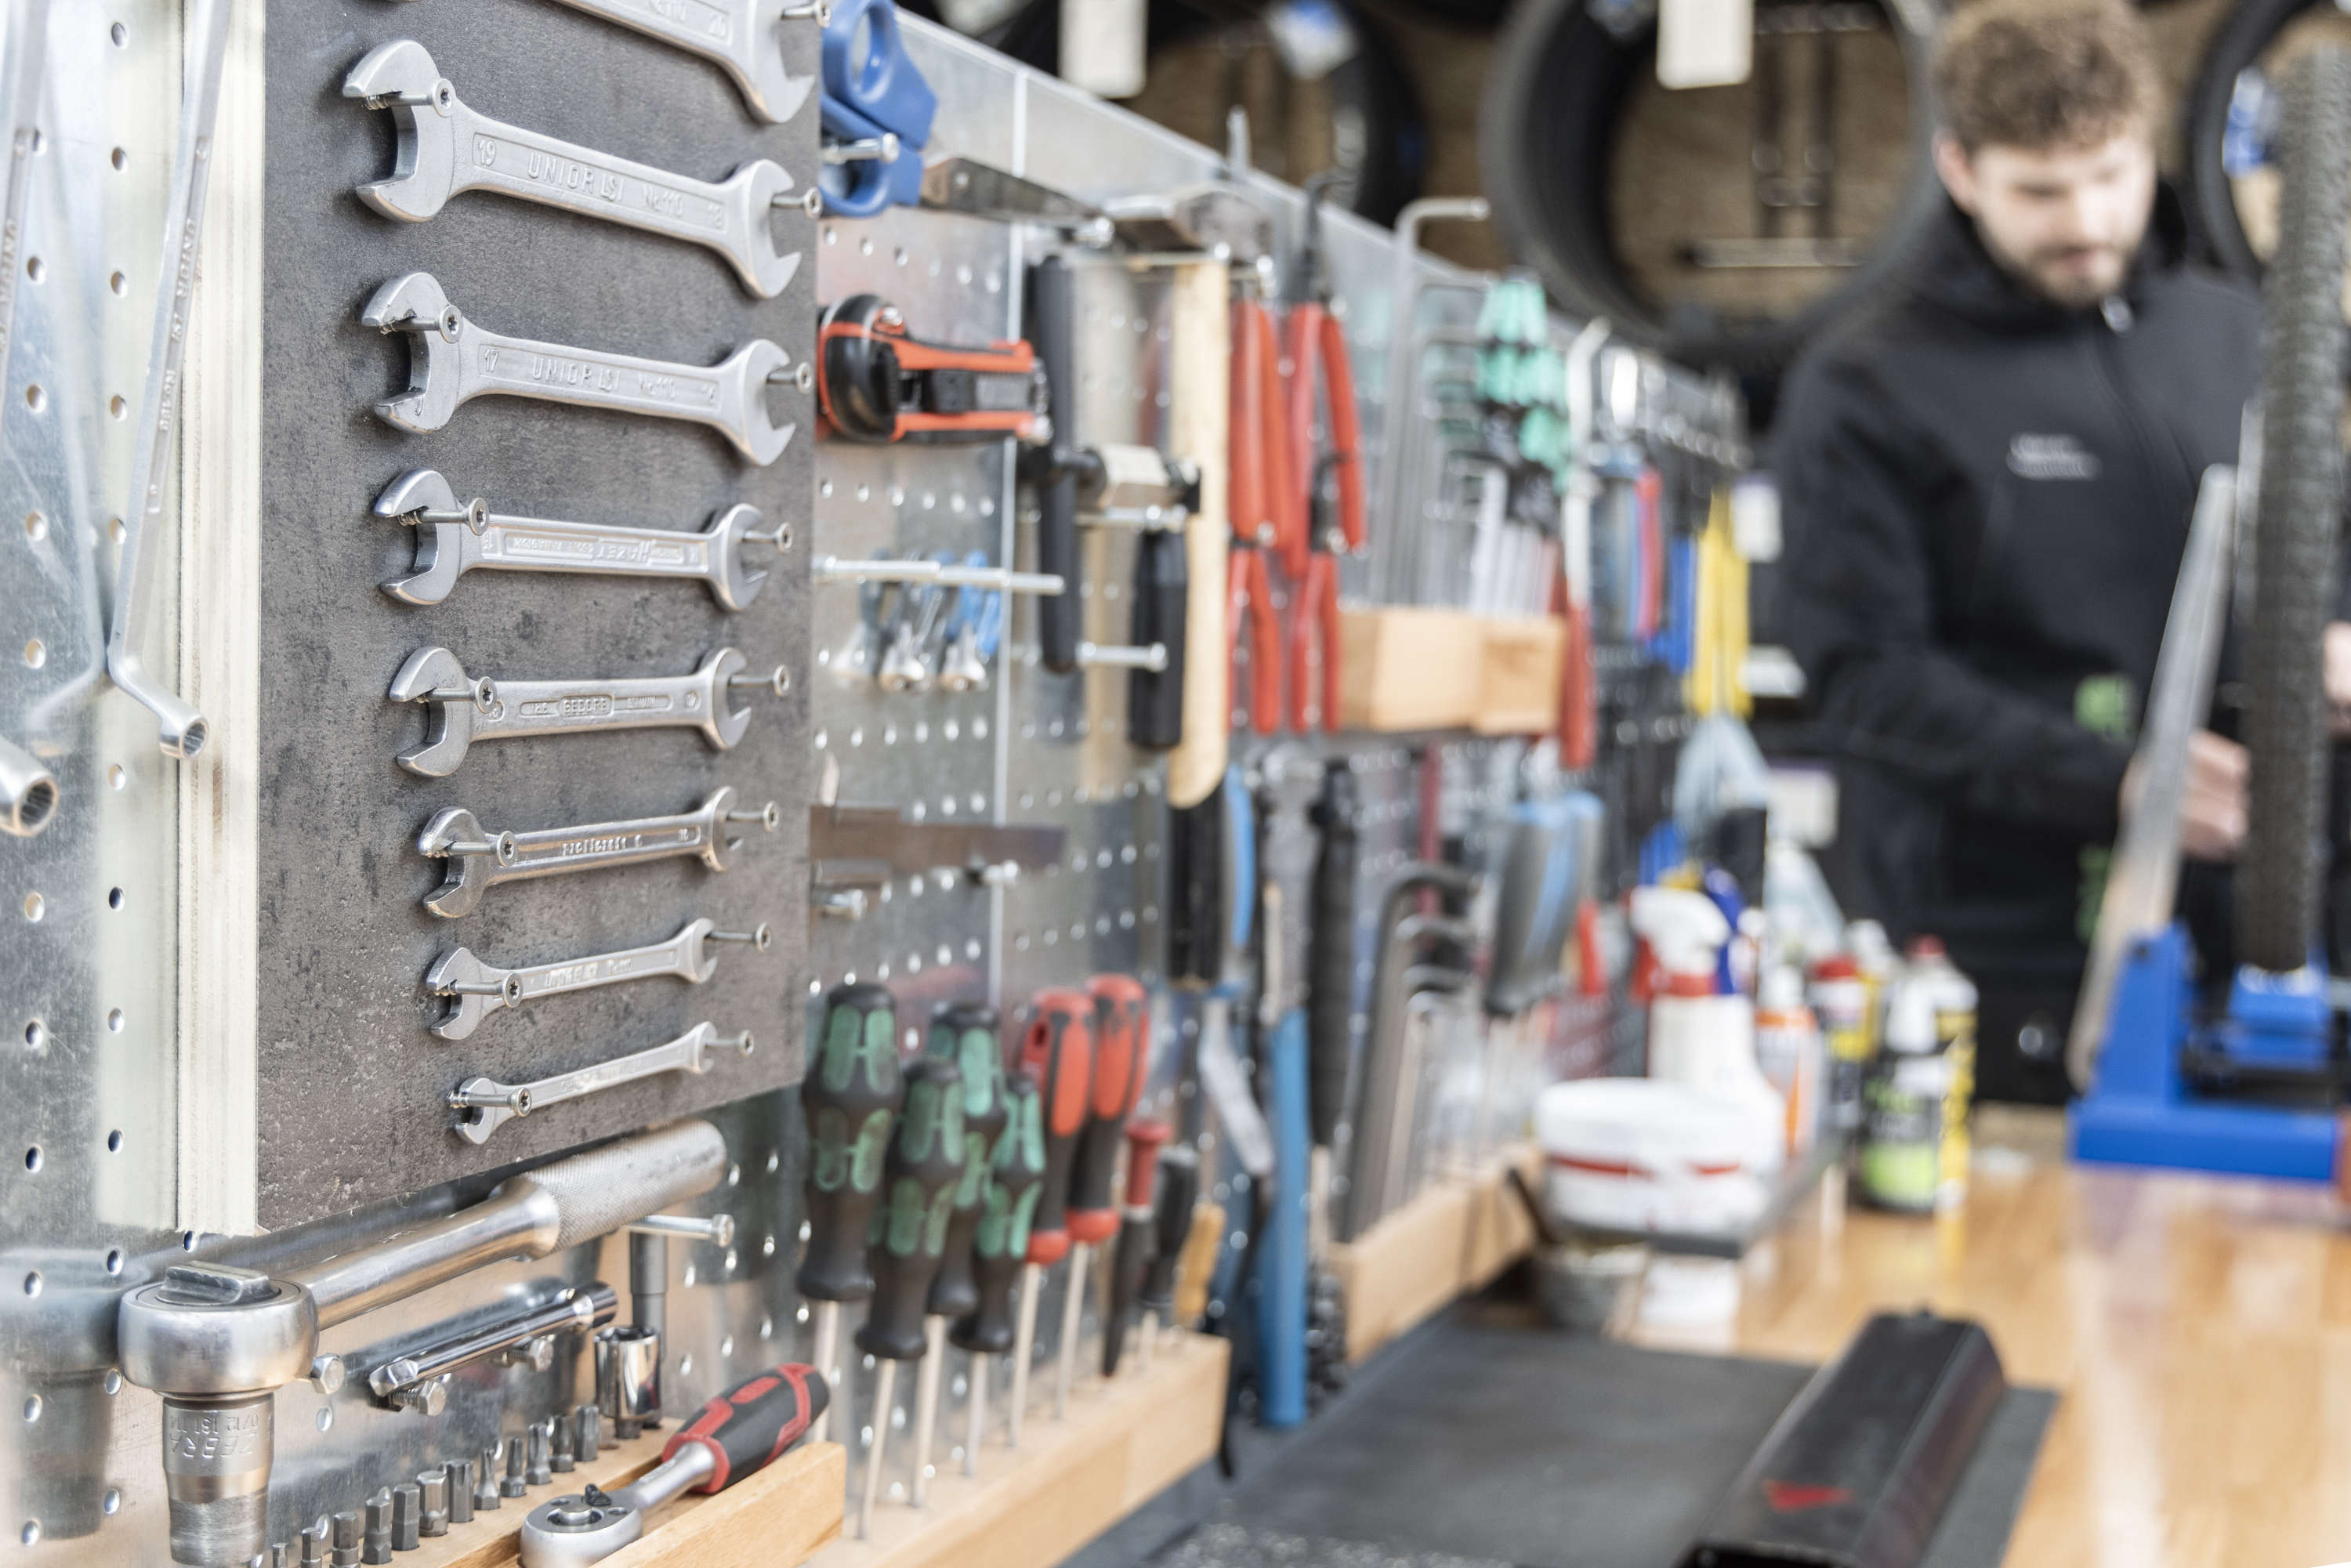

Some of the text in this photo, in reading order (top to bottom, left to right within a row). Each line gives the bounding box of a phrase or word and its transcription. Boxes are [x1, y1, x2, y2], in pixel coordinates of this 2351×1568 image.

[476, 138, 497, 168] 19
[527, 150, 595, 194] UNIOR
[483, 349, 500, 374] 17
[532, 356, 592, 389] UNIOR
[563, 697, 609, 715] GEDORE
[169, 1432, 257, 1459] ZEBRA
